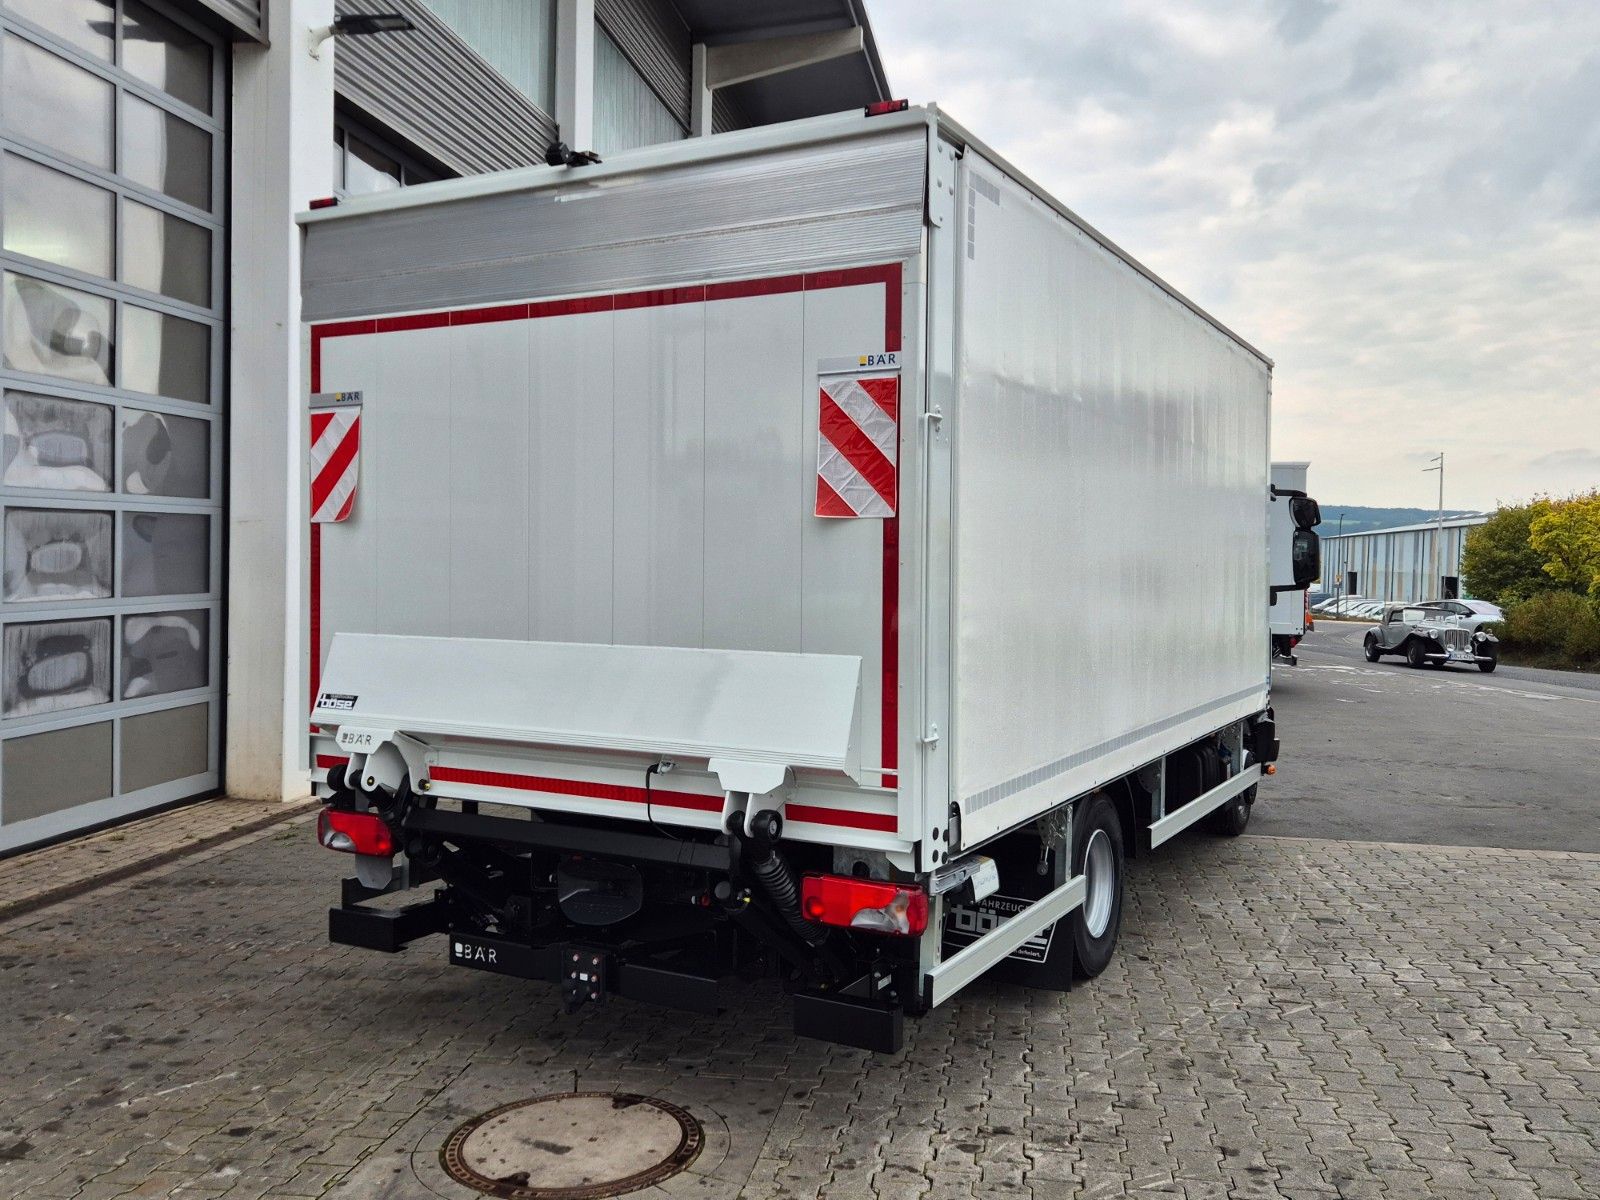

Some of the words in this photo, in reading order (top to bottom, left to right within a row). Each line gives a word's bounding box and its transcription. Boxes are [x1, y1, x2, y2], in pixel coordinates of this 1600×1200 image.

[867, 353, 896, 366] BÄR
[348, 733, 372, 746] BÄR
[464, 944, 497, 964] BÄR
